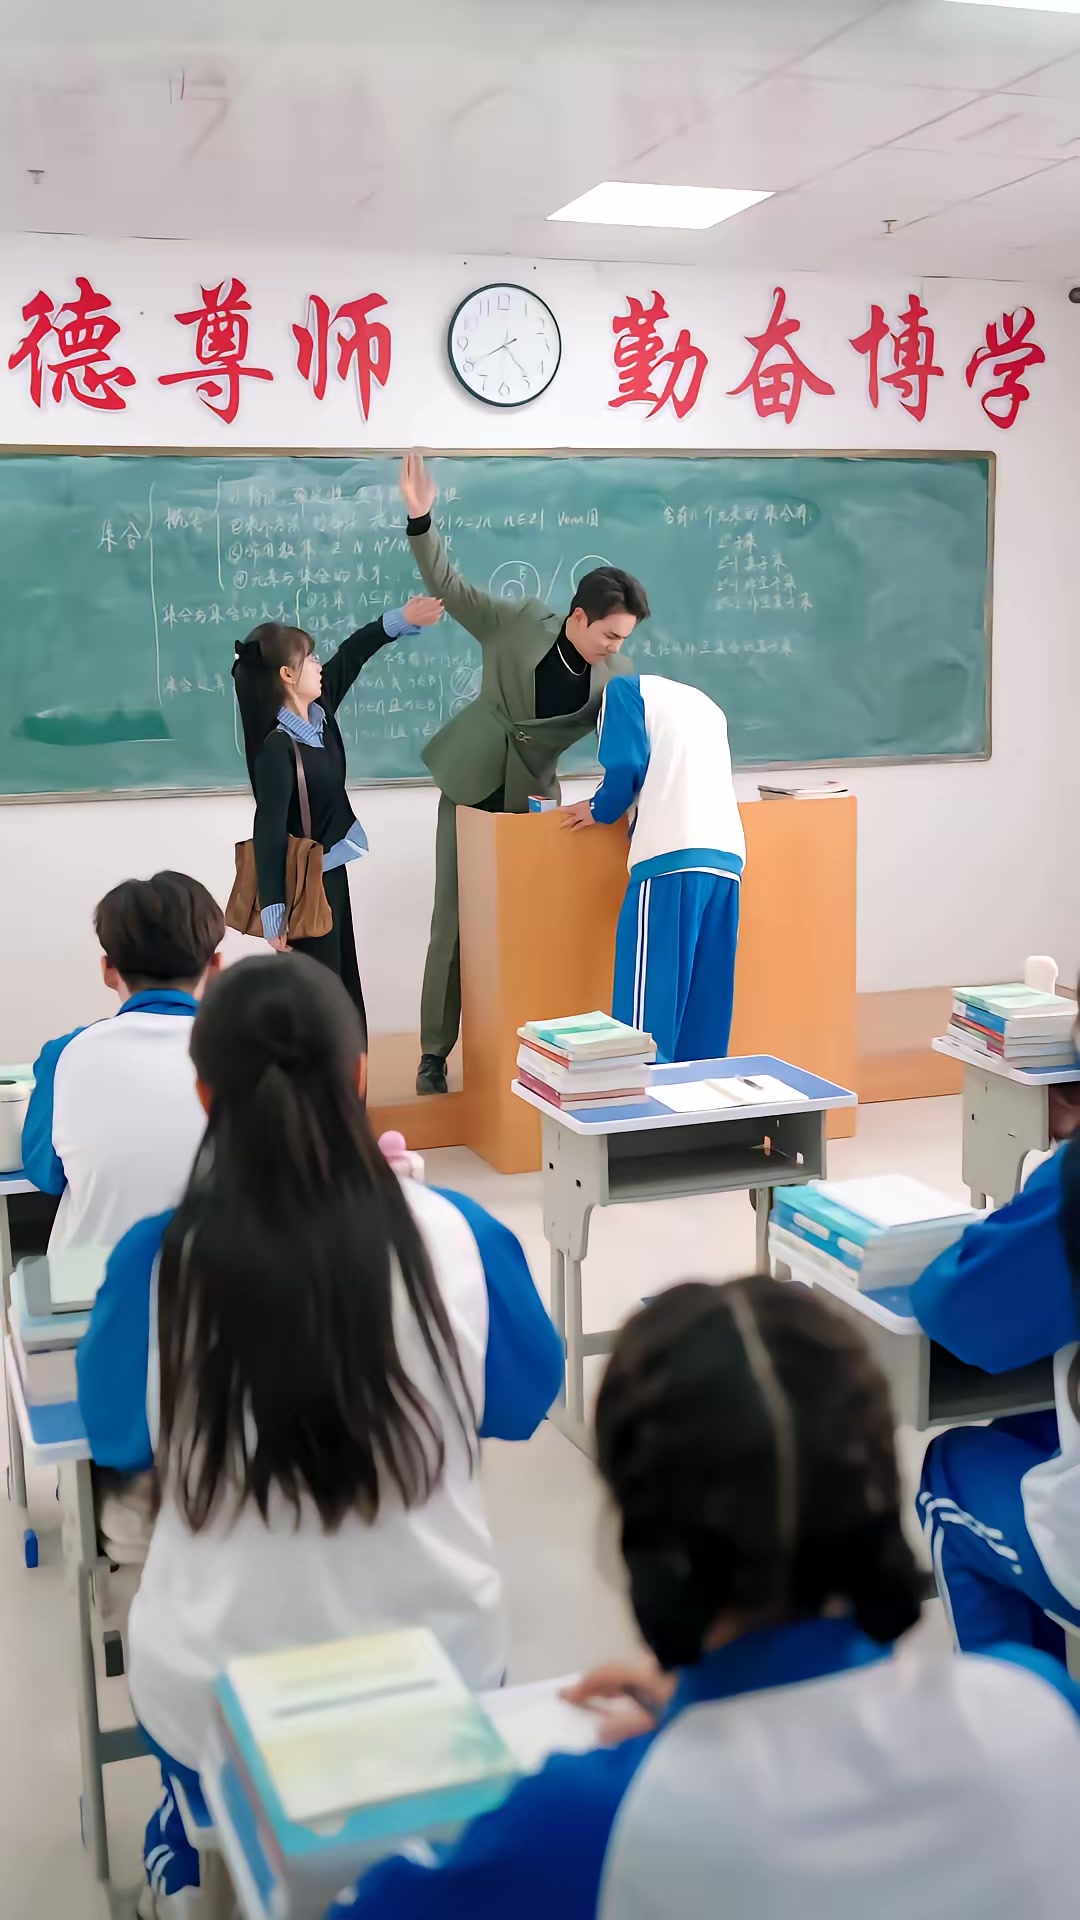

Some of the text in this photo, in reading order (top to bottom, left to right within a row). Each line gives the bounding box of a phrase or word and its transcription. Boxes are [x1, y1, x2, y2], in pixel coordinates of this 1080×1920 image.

[7, 276, 1046, 430] 德尊师 勤奋博学
